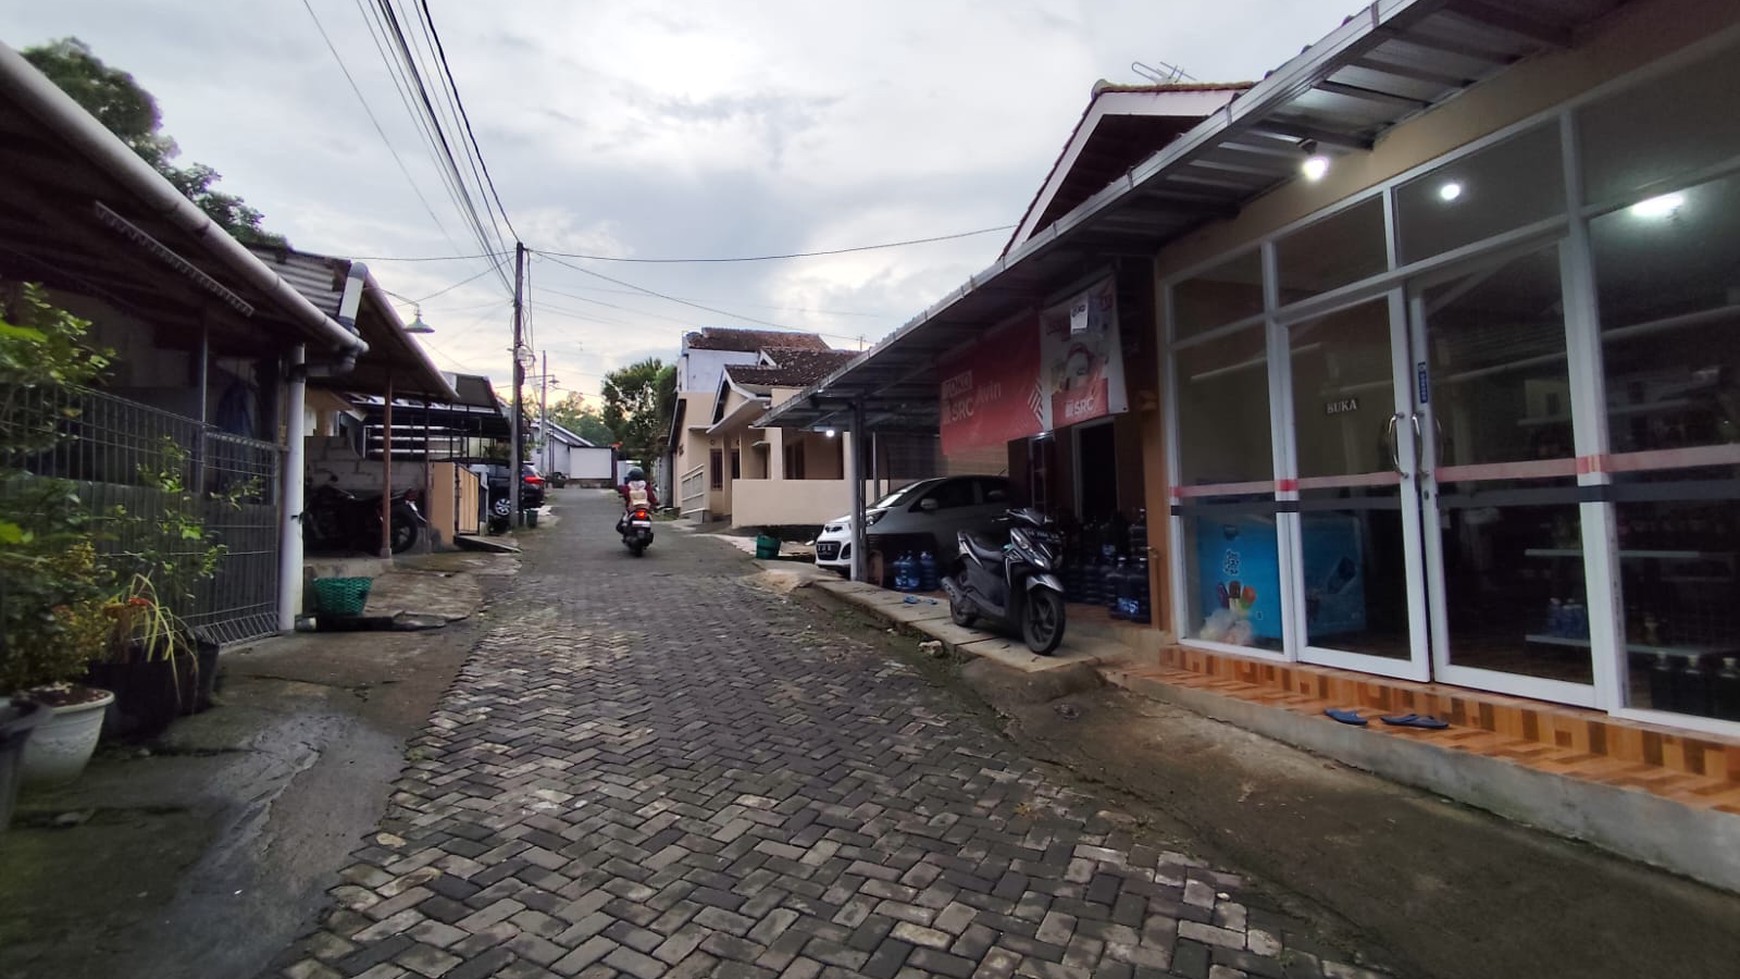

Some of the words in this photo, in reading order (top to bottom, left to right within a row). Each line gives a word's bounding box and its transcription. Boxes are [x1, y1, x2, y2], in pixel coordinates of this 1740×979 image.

[945, 374, 970, 397] TOKO
[952, 398, 974, 422] SRC
[1074, 397, 1094, 415] SRC
[1326, 399, 1357, 414] BUKA
